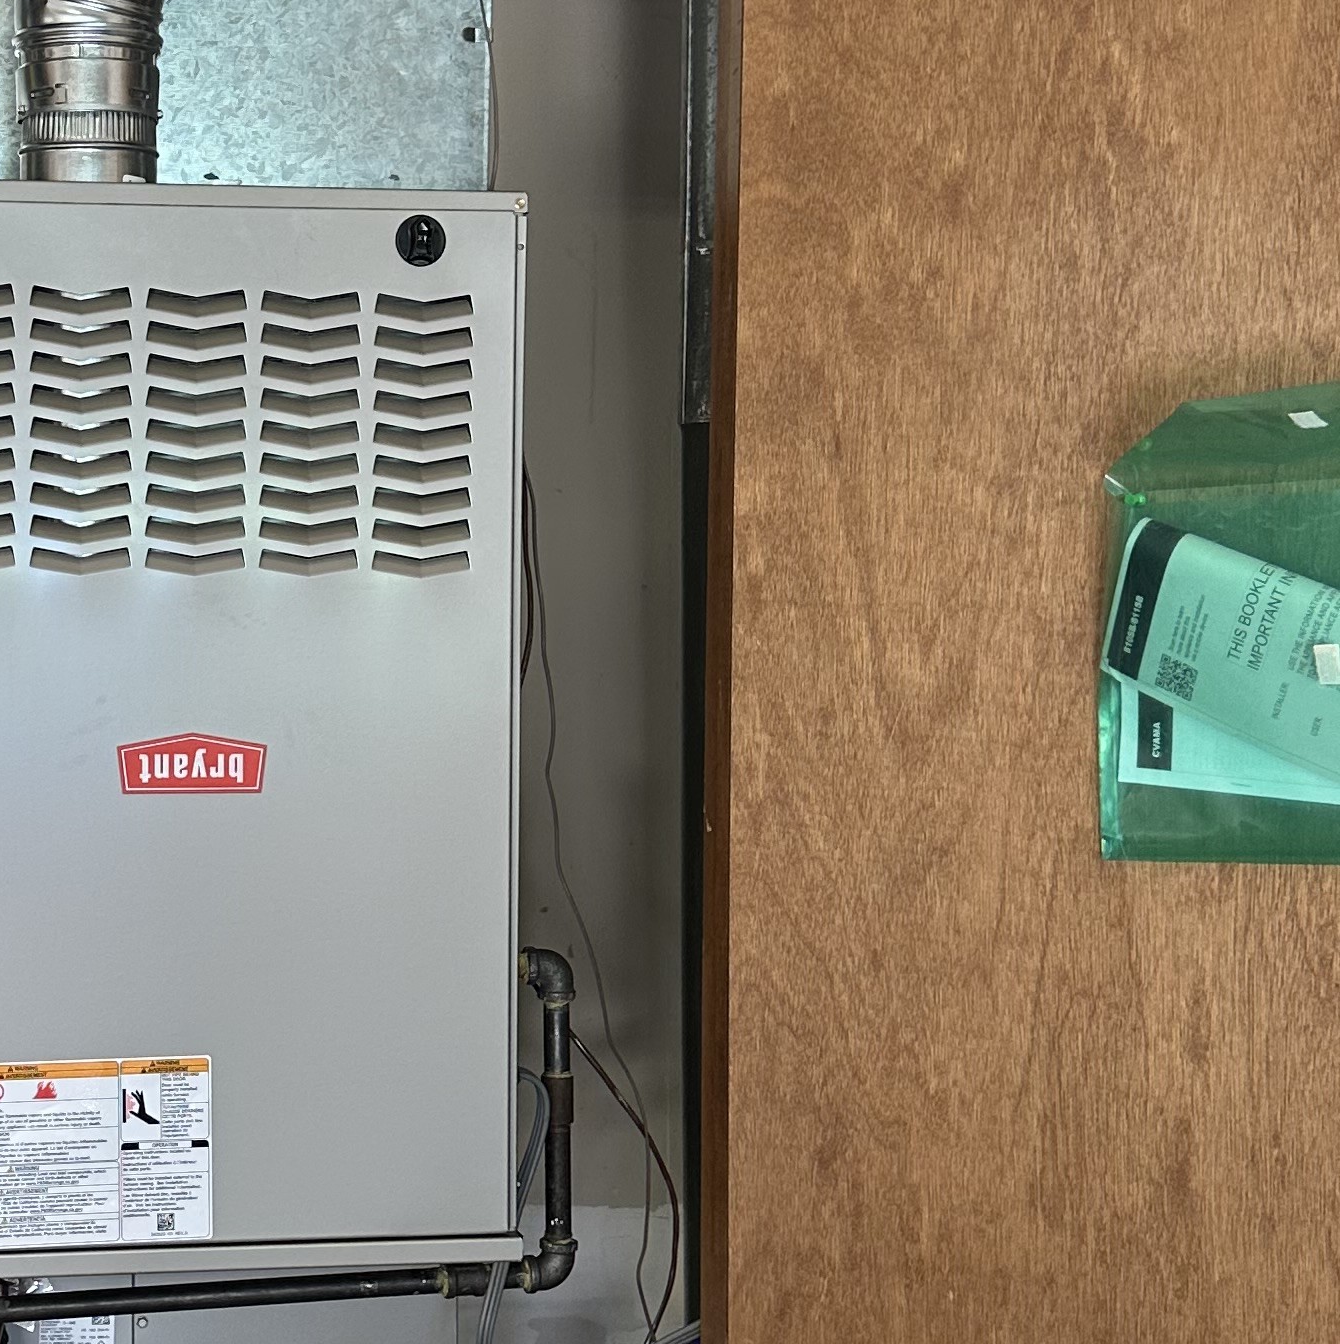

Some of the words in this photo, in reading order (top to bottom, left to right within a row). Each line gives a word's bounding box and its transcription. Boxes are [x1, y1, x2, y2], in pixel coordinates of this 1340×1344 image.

[1227, 628, 1248, 662] THIS
[1247, 588, 1283, 672] IMPORTANT
[139, 748, 244, 784] bryant
